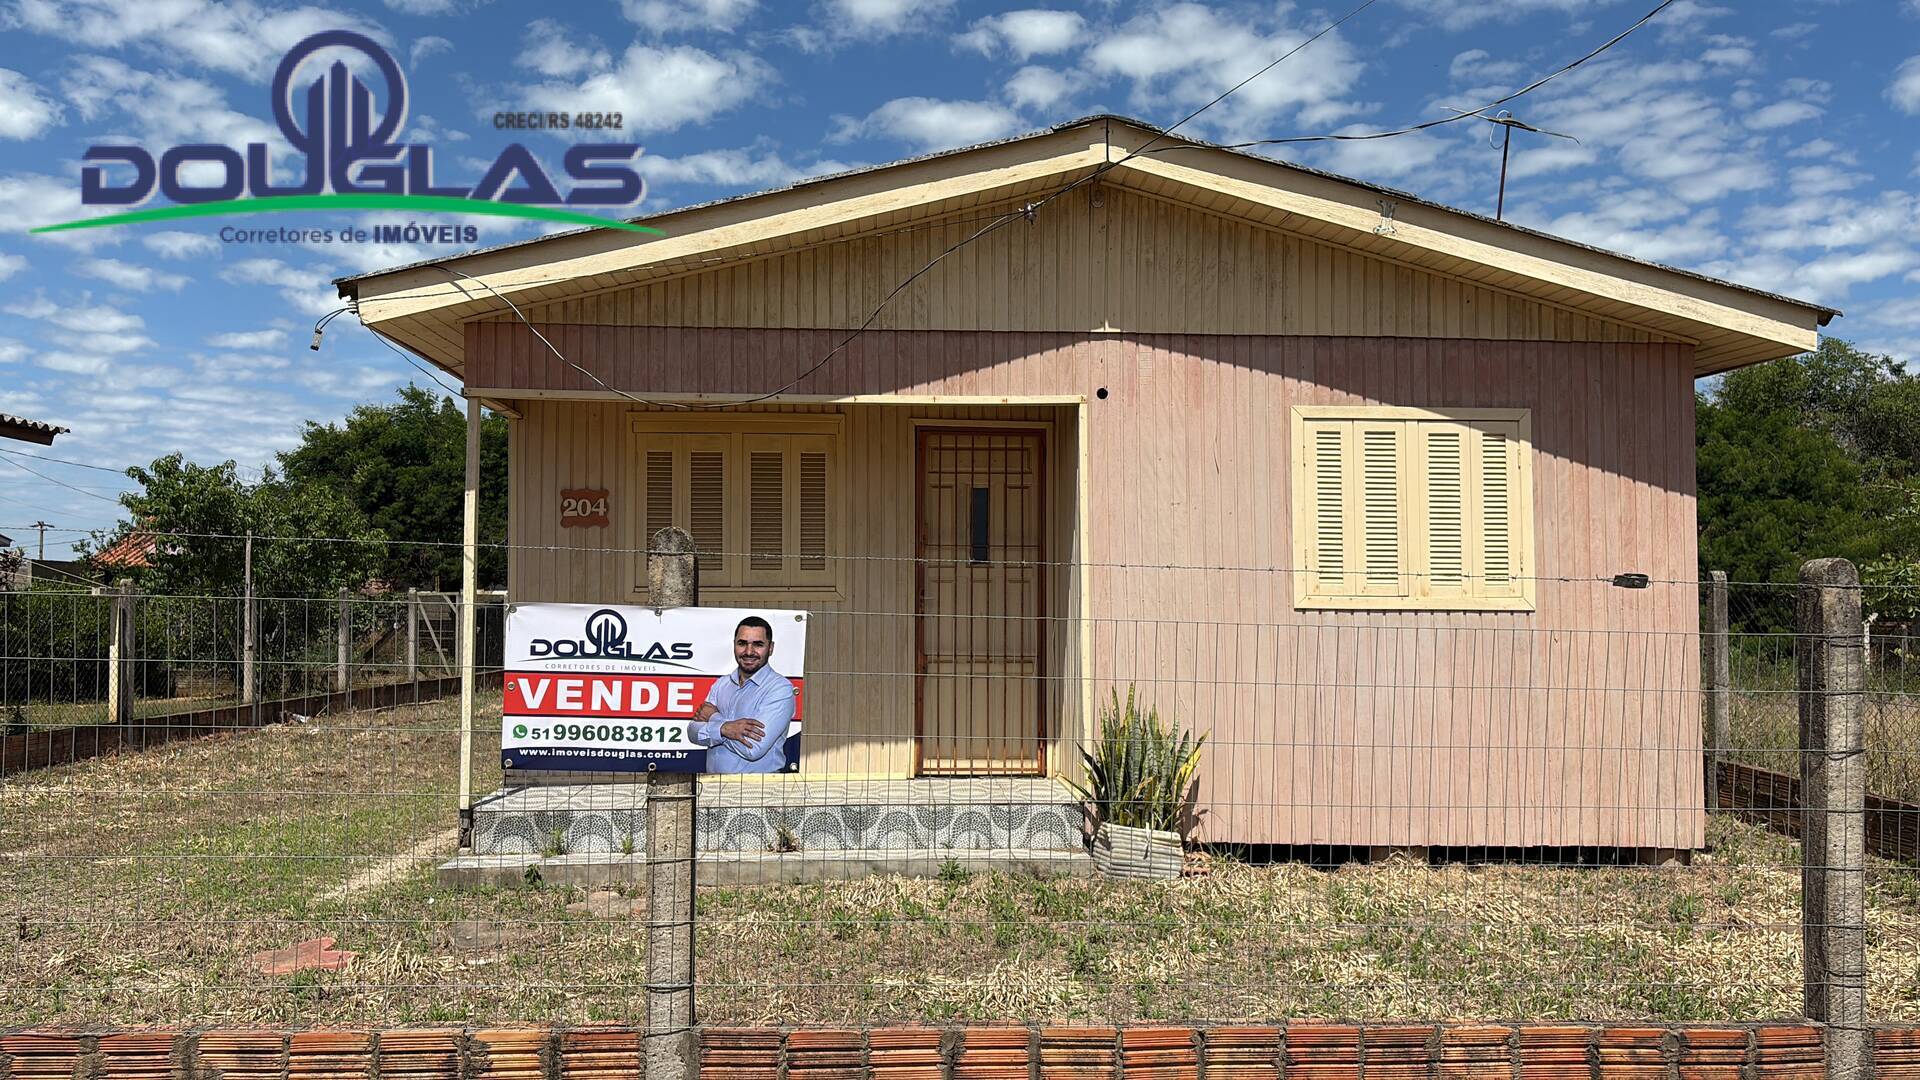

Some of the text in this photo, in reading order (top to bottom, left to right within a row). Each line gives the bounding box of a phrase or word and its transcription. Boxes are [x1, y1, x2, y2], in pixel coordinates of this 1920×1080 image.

[563, 498, 607, 517] 204
[530, 639, 694, 660] DOUGLAS
[545, 663, 600, 671] CORRETORES
[620, 664, 657, 672] IMÓVEIS
[517, 678, 695, 713] VENDE
[531, 724, 683, 743] 51 996083812
[519, 748, 688, 759] www.imoveisdouglas.com.br
